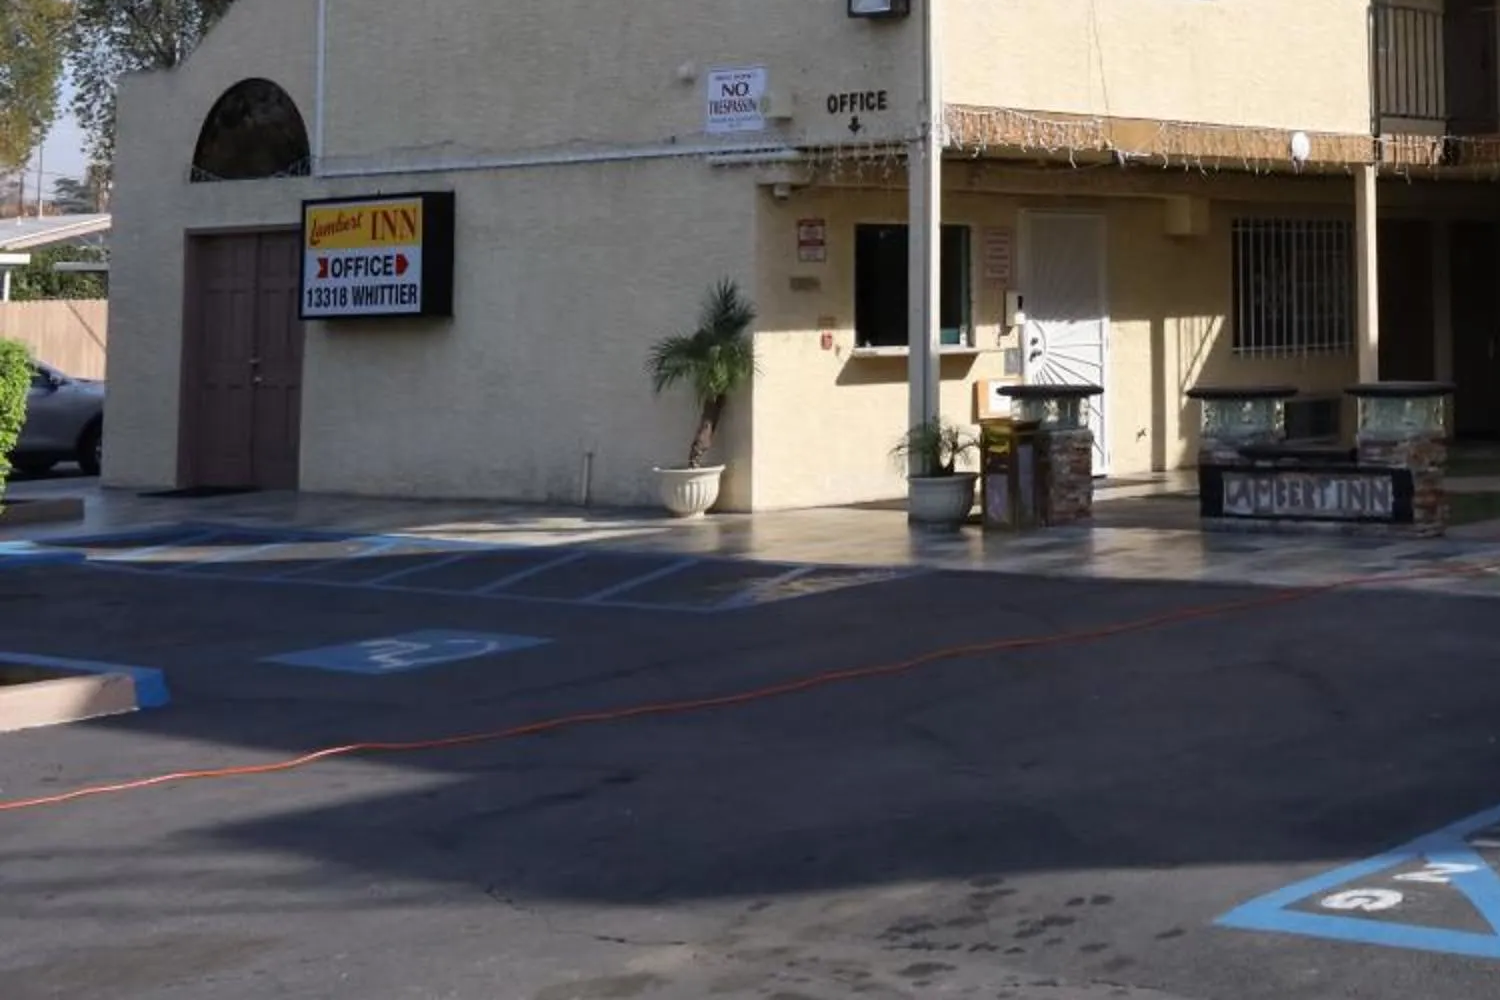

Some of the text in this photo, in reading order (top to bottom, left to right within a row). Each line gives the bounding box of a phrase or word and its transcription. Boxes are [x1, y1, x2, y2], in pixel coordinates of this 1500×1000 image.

[721, 81, 750, 97] NO
[826, 90, 888, 114] OFFICE
[370, 208, 418, 241] INN
[331, 255, 393, 278] OFFICE
[306, 284, 418, 308] 13318 WHITTIER
[1337, 478, 1391, 511] INN
